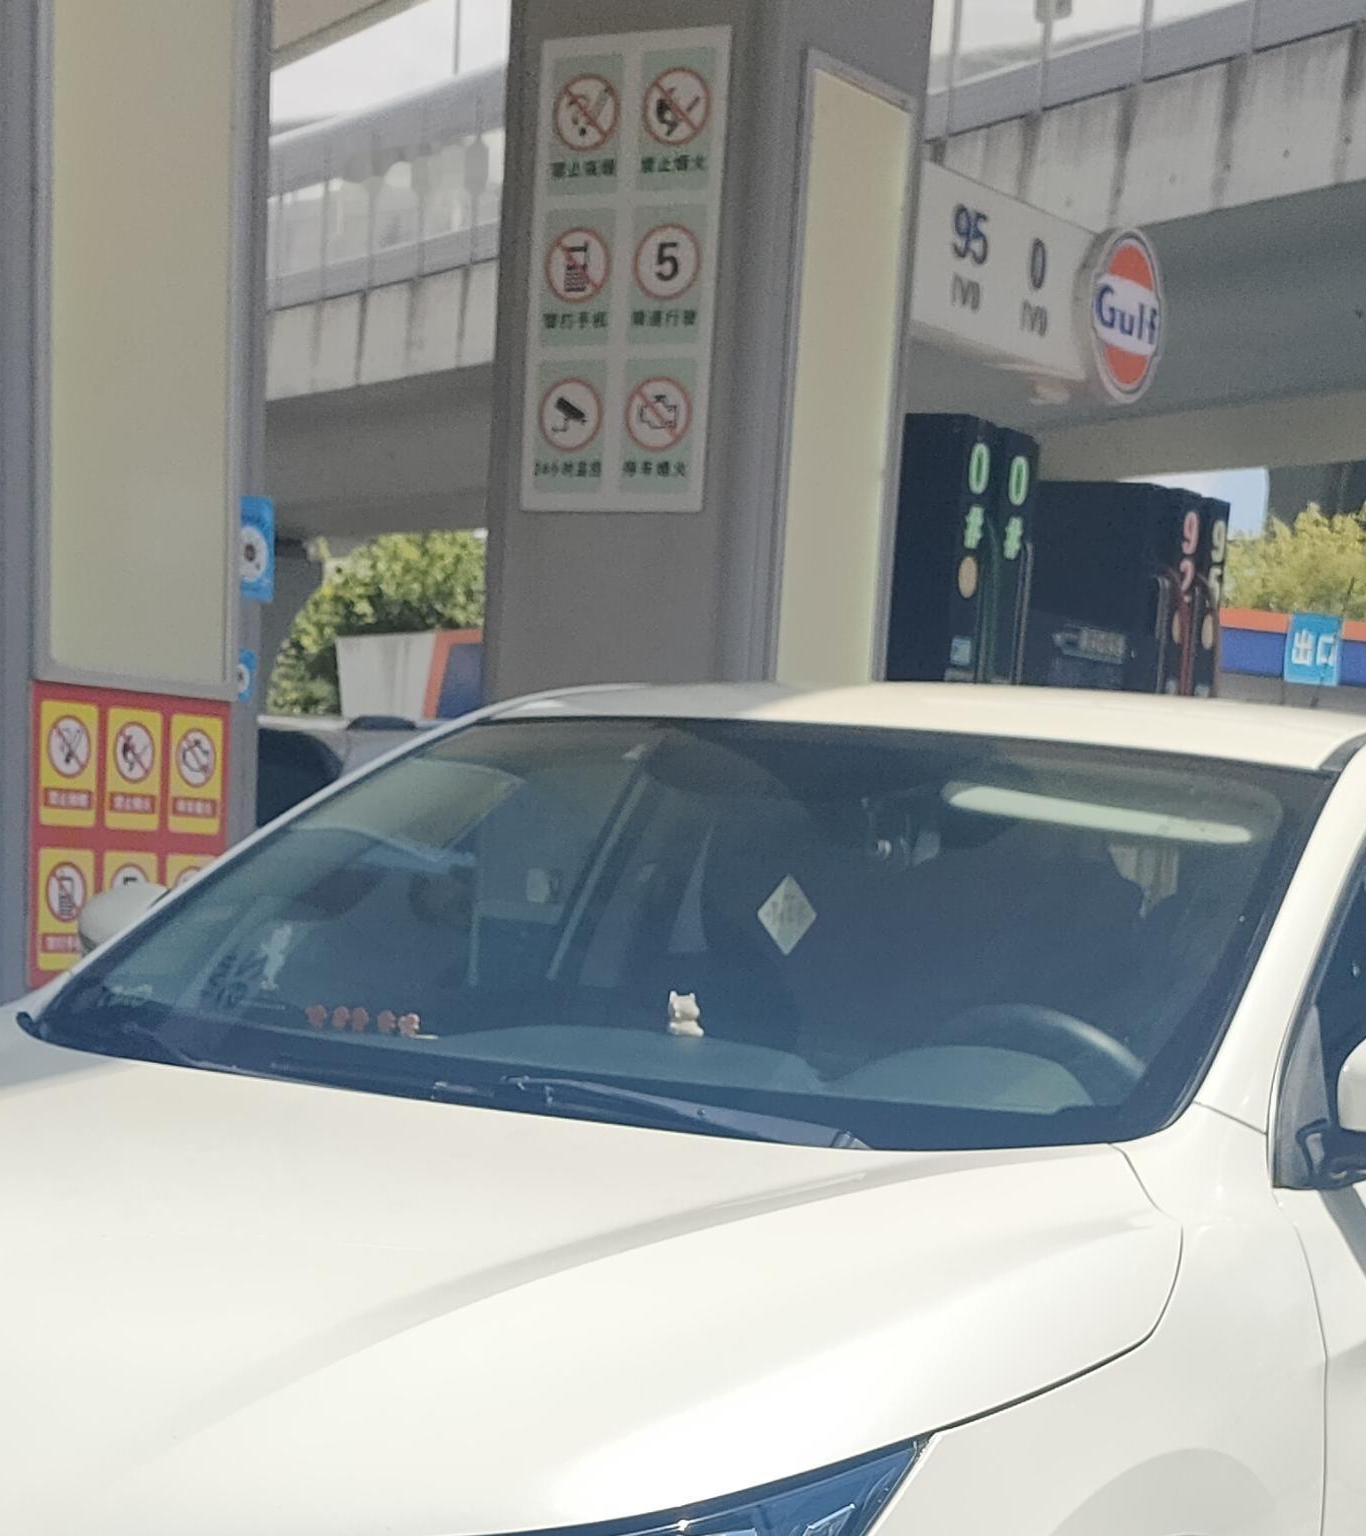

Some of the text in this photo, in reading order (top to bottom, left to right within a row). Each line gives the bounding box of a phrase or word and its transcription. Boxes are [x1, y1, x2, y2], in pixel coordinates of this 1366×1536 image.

[952, 203, 989, 264] 95
[655, 241, 680, 283] 5
[1094, 284, 1158, 346] Gulf
[1291, 628, 1336, 667] 出口
